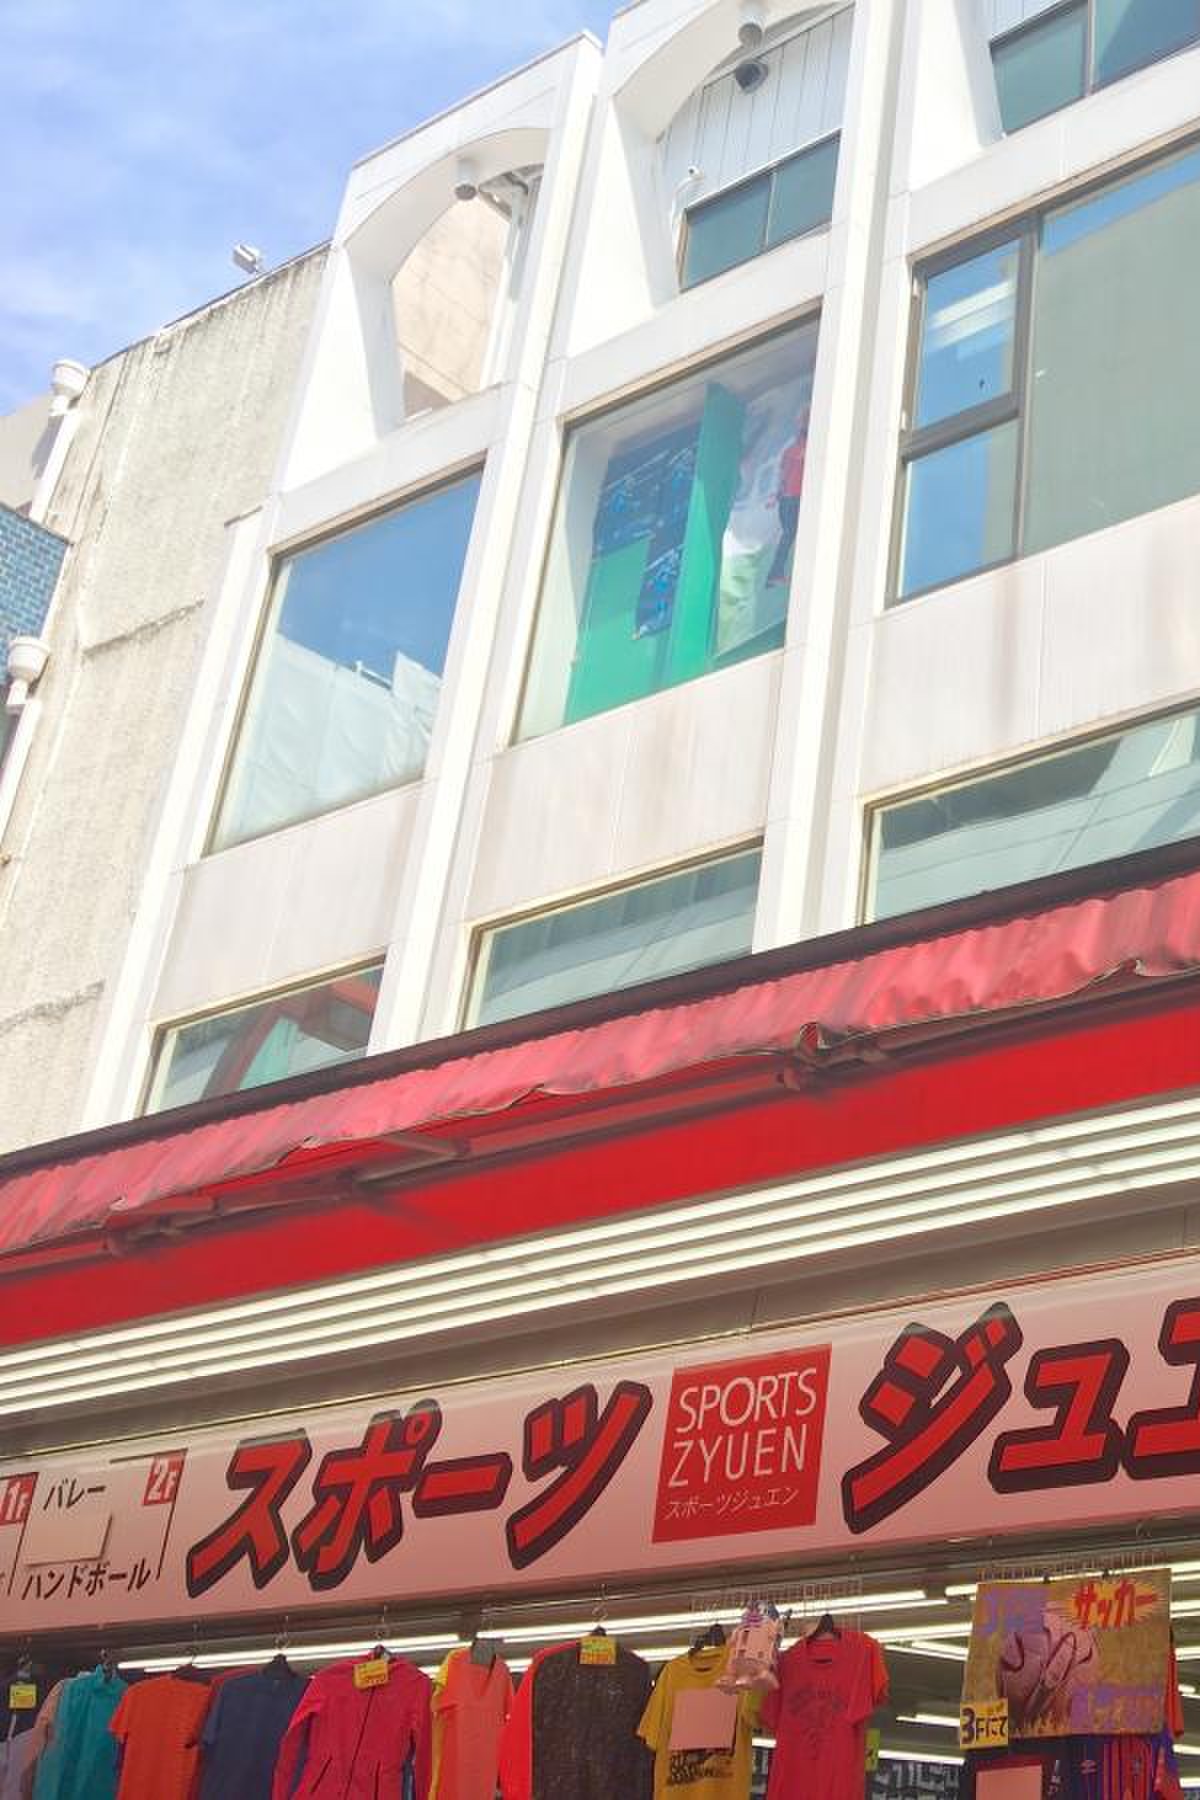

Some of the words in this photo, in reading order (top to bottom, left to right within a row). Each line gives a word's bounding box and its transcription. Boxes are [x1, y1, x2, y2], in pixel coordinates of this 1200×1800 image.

[675, 1367, 817, 1434] SPORTS
[668, 1423, 807, 1488] ZYUEN
[43, 1478, 107, 1511] バレー
[147, 1457, 178, 1502] 2F
[186, 1379, 653, 1598] スポーツ
[664, 1487, 799, 1520] スポーツジュエン
[22, 1557, 151, 1600] ハンドボール
